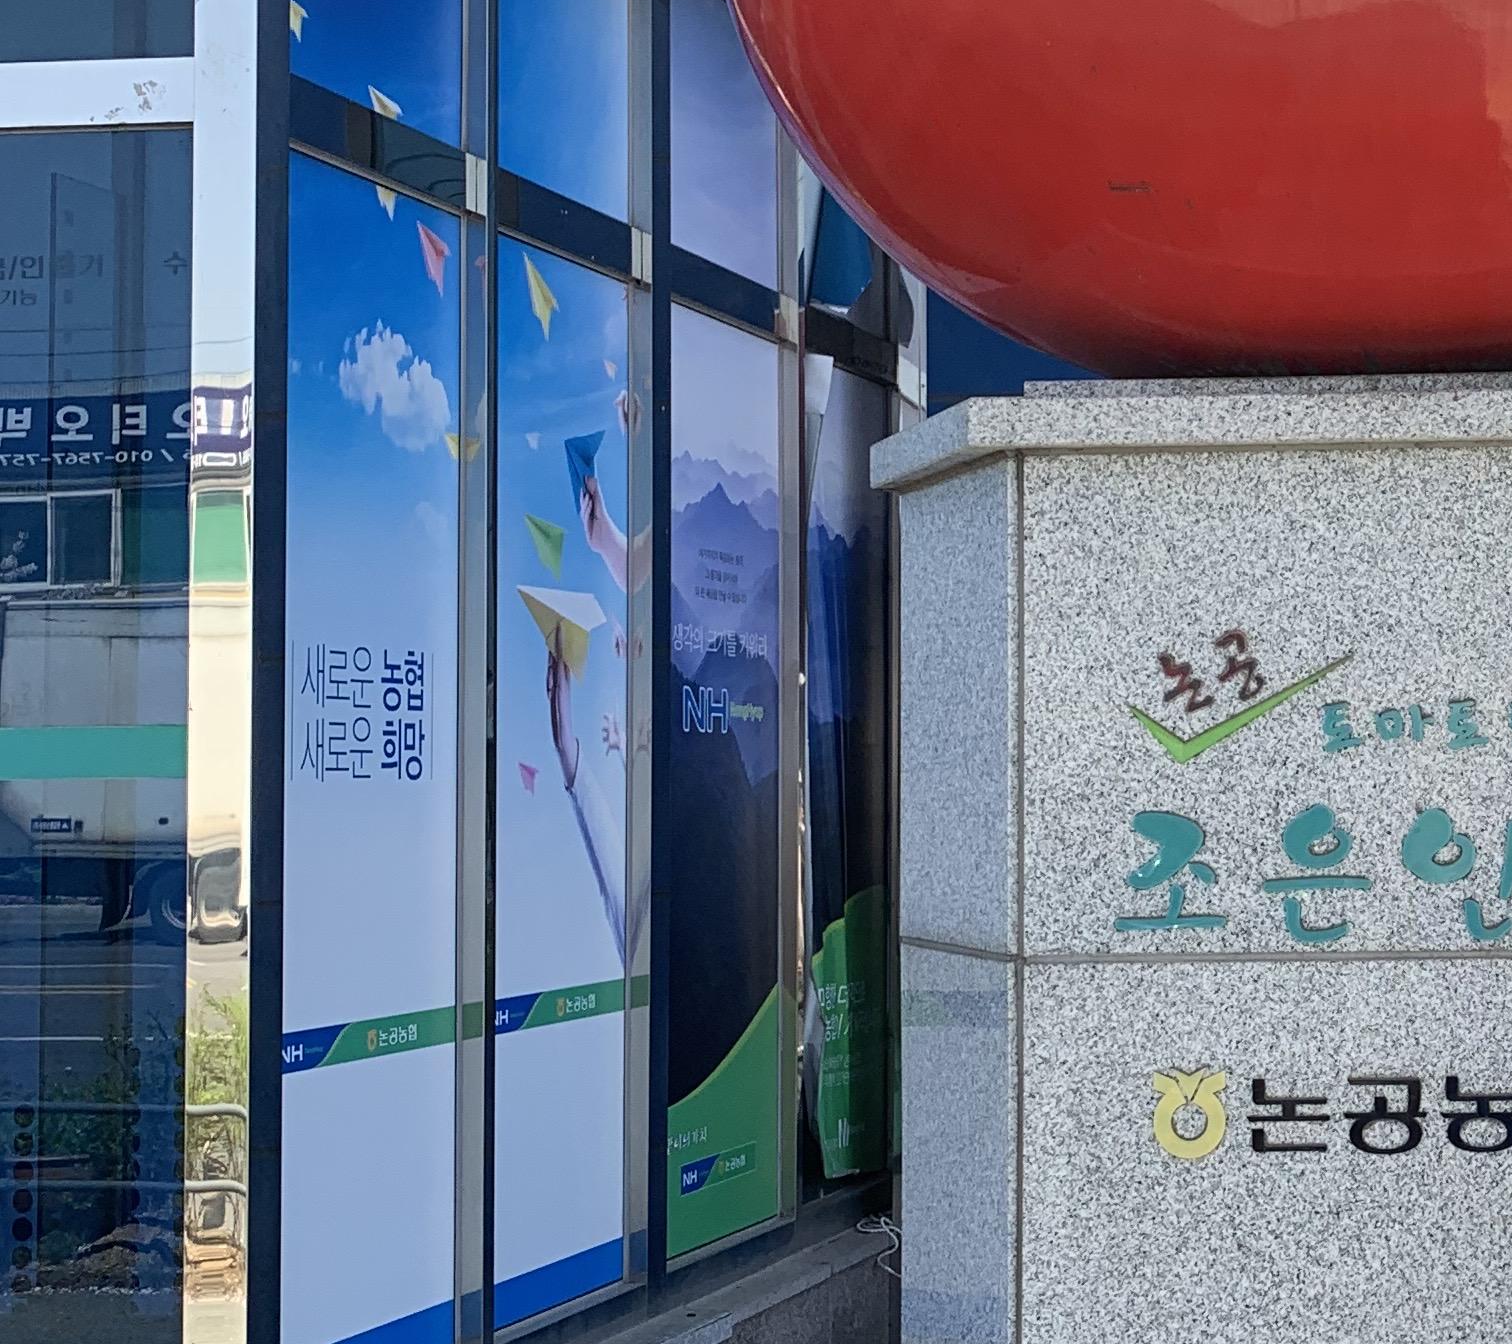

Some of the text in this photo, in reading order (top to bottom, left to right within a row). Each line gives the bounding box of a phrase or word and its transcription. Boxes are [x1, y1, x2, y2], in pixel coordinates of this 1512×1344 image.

[301, 643, 425, 712] 새로운 농협
[682, 684, 730, 734] NH
[300, 717, 426, 783] 새로운 희망
[379, 1023, 418, 1047] 논공농협
[682, 1169, 698, 1188] NH
